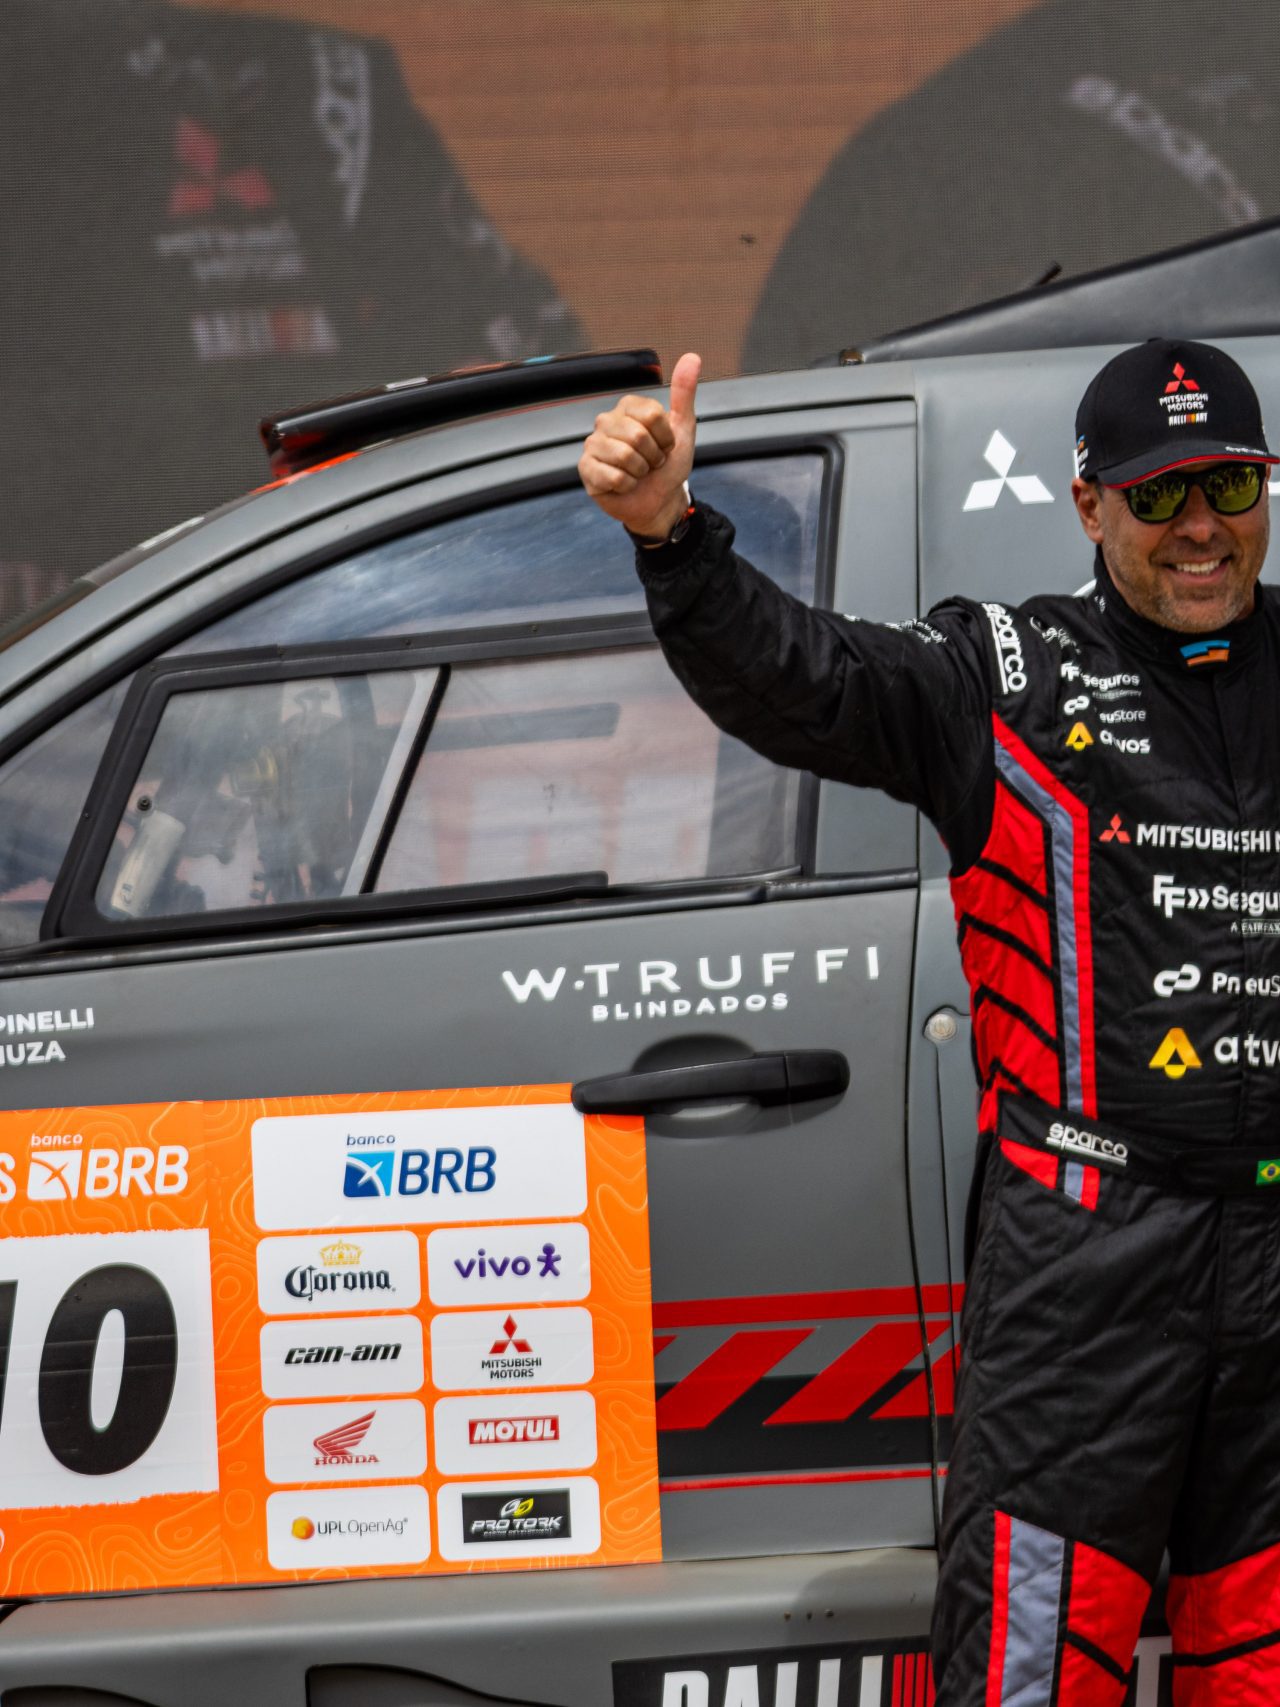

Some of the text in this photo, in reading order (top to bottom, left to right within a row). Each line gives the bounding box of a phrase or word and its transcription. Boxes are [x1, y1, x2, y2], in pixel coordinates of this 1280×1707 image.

[1159, 393, 1209, 405] MITSUBISHI
[1167, 401, 1204, 412] MOTORS
[1136, 823, 1271, 853] MITSUBISHI
[592, 992, 789, 1022] BLINDADOS
[31, 1133, 83, 1147] banco
[346, 1133, 396, 1146] banco
[1046, 1122, 1129, 1166] sparco
[85, 1145, 189, 1200] BRB
[398, 1145, 497, 1196] BRB
[454, 1248, 531, 1279] vivo
[284, 1264, 392, 1302] Corona
[284, 1342, 402, 1366] can-am
[481, 1358, 542, 1370] MITSUBISHI
[489, 1367, 534, 1380] MOTORS
[473, 1418, 556, 1443] MOTUL
[314, 1453, 380, 1467] HONDA
[471, 1518, 511, 1534] PRO
[512, 1515, 563, 1531] TORK
